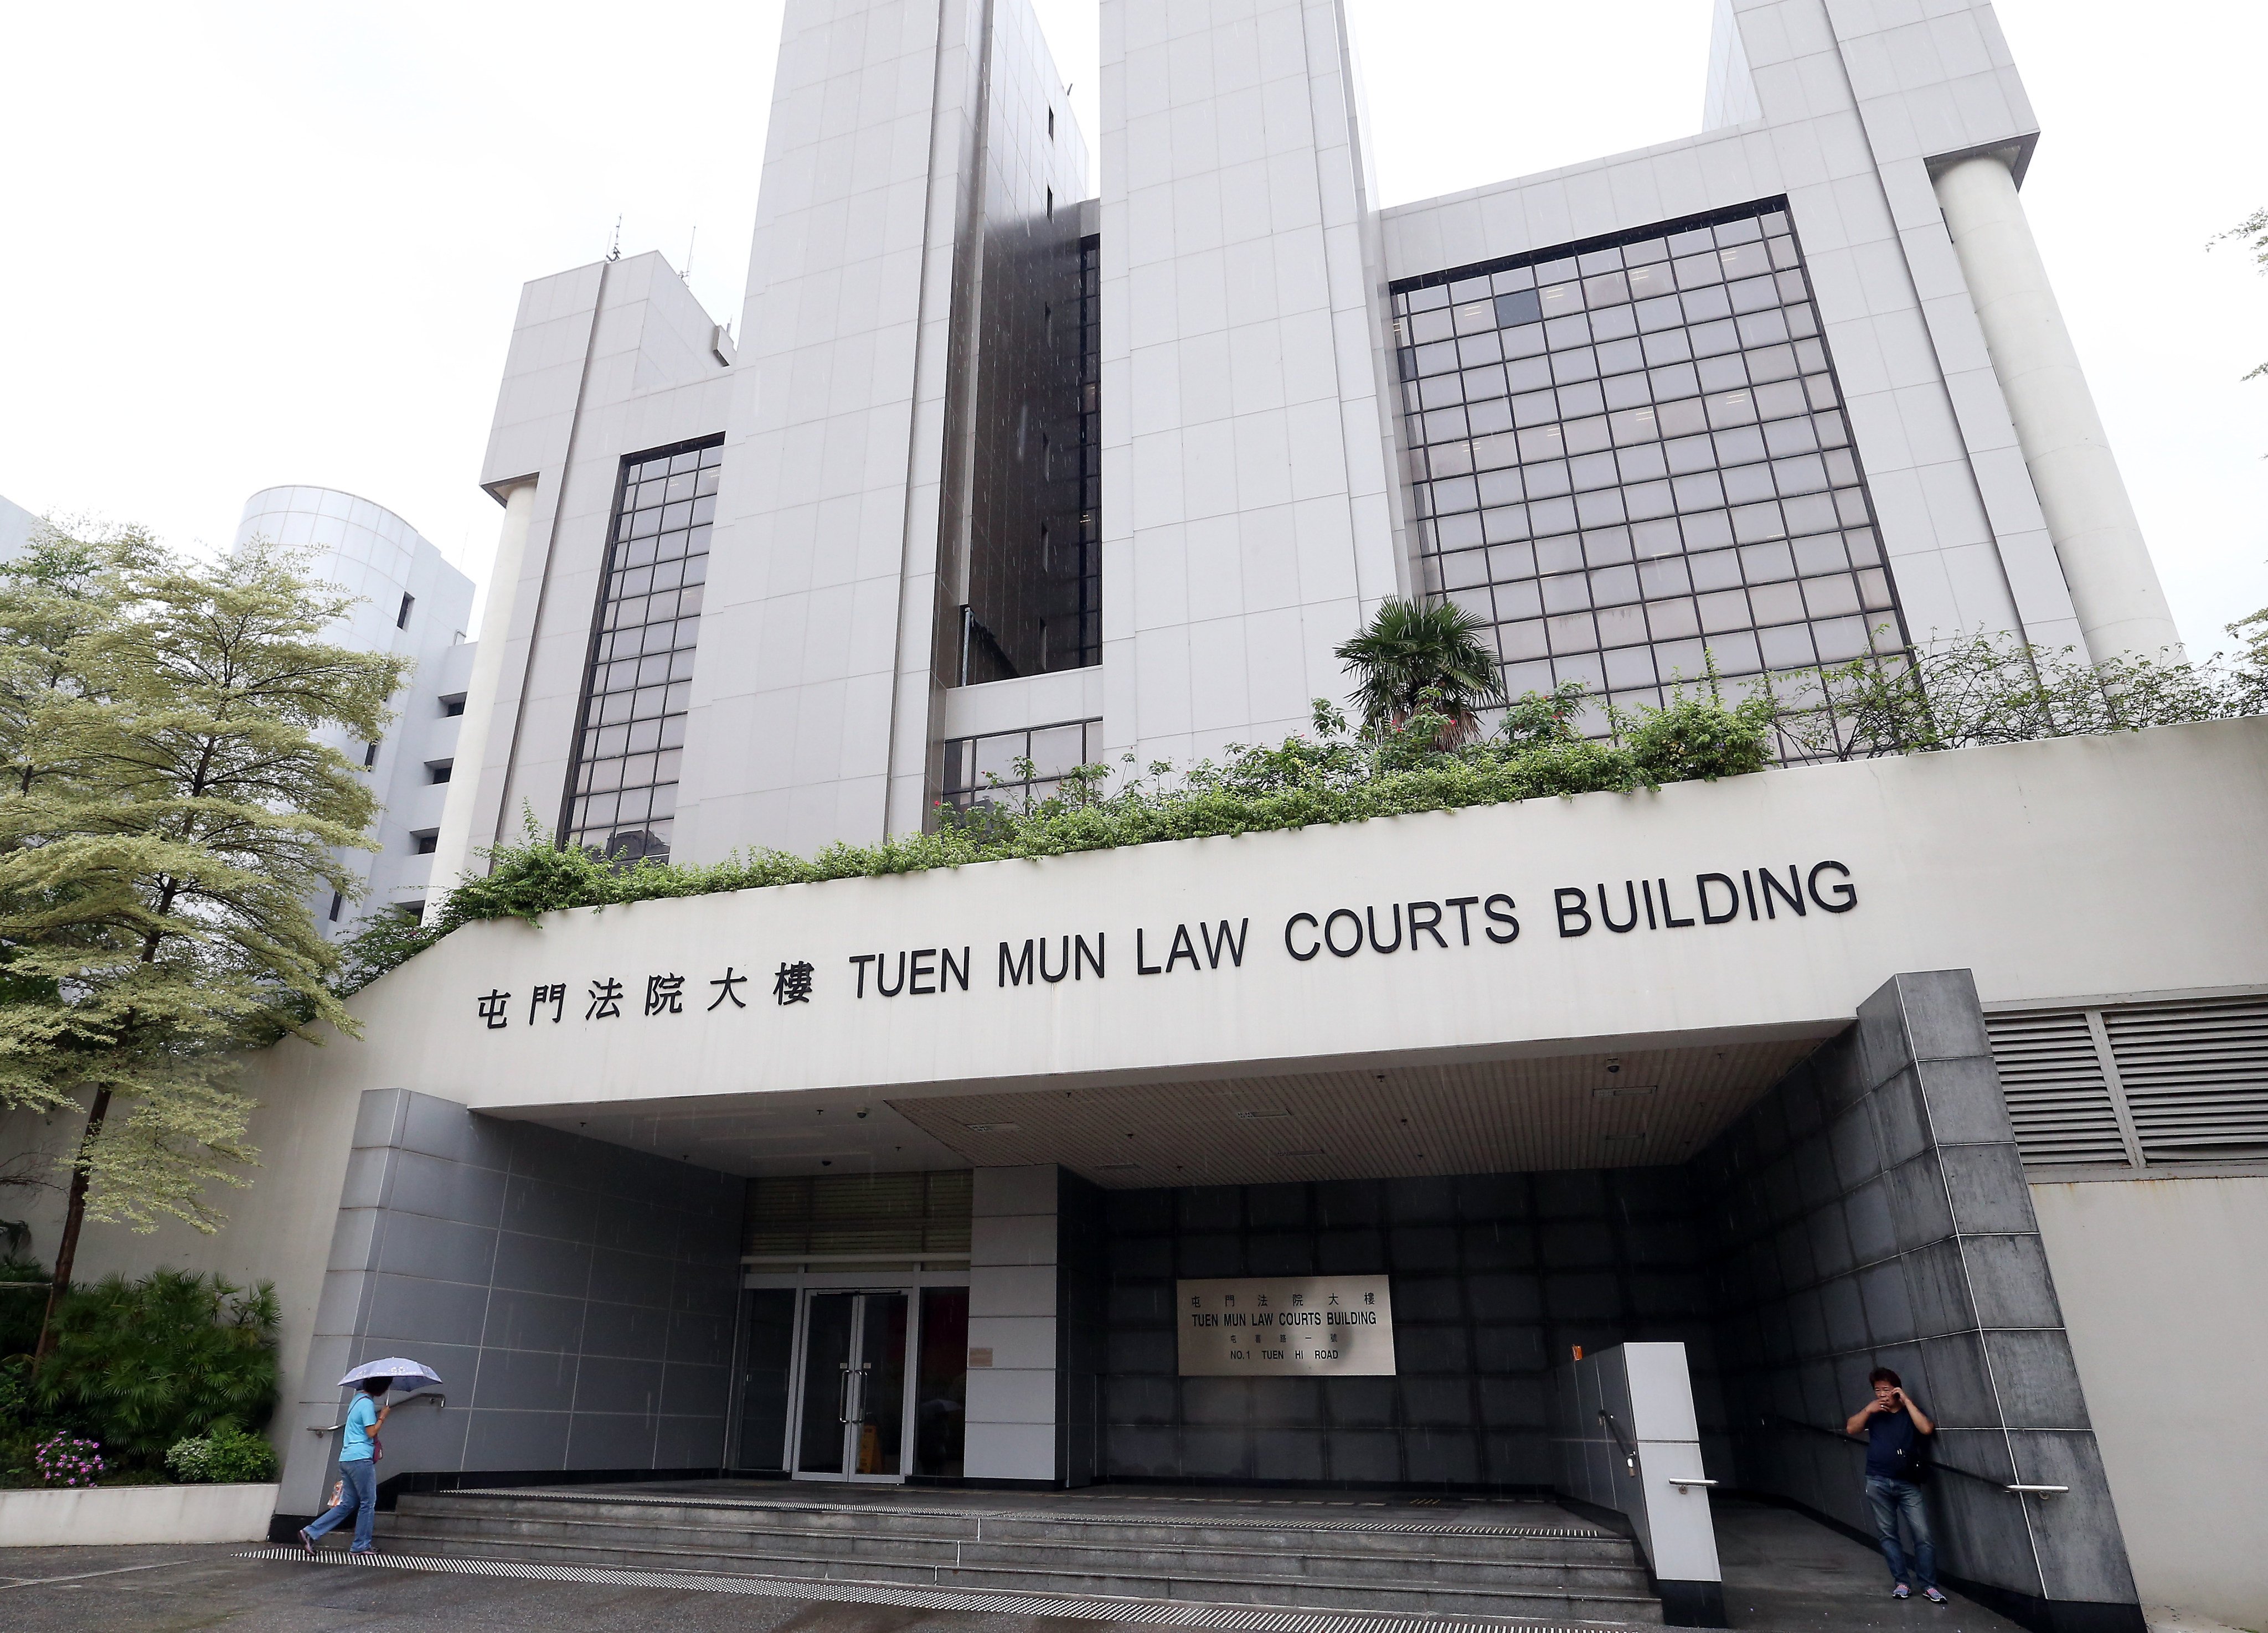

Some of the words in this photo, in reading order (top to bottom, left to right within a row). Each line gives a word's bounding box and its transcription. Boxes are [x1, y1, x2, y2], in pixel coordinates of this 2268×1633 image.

[849, 946, 970, 999] TUEN
[998, 932, 1105, 988] MUN
[1136, 917, 1249, 975] LAW
[1285, 893, 1520, 962] COURTS
[1553, 860, 1858, 939] BUILDING
[477, 960, 815, 1030] 屯門法院大樓
[1191, 1292, 1375, 1308] 屯門法院大樓
[1192, 1314, 1218, 1327] TUEN
[1224, 1313, 1246, 1327] MUN
[1251, 1312, 1274, 1326] LAW
[1279, 1312, 1321, 1326] COURTS
[1327, 1311, 1377, 1326] BUILDING
[1230, 1350, 1250, 1360] NO.1
[1262, 1350, 1284, 1360] TUEN
[1295, 1350, 1303, 1360] HI
[1315, 1350, 1338, 1360] ROAD
